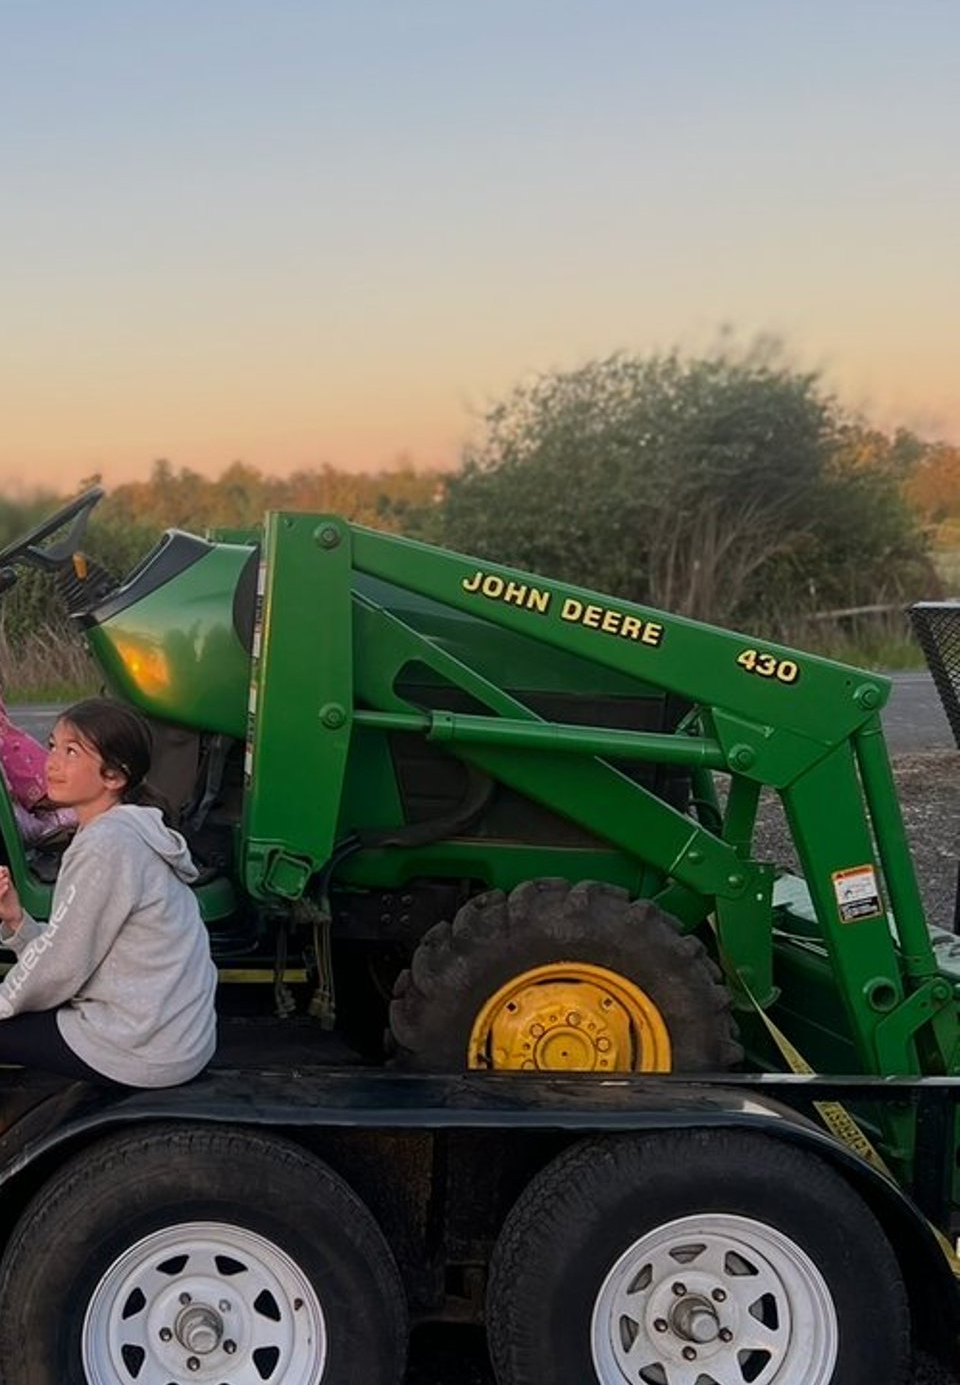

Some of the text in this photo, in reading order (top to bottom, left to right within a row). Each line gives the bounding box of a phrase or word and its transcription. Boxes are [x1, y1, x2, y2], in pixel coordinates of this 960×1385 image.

[462, 571, 798, 683] JOHN DEERE 430
[7, 883, 77, 1001] carhartt
